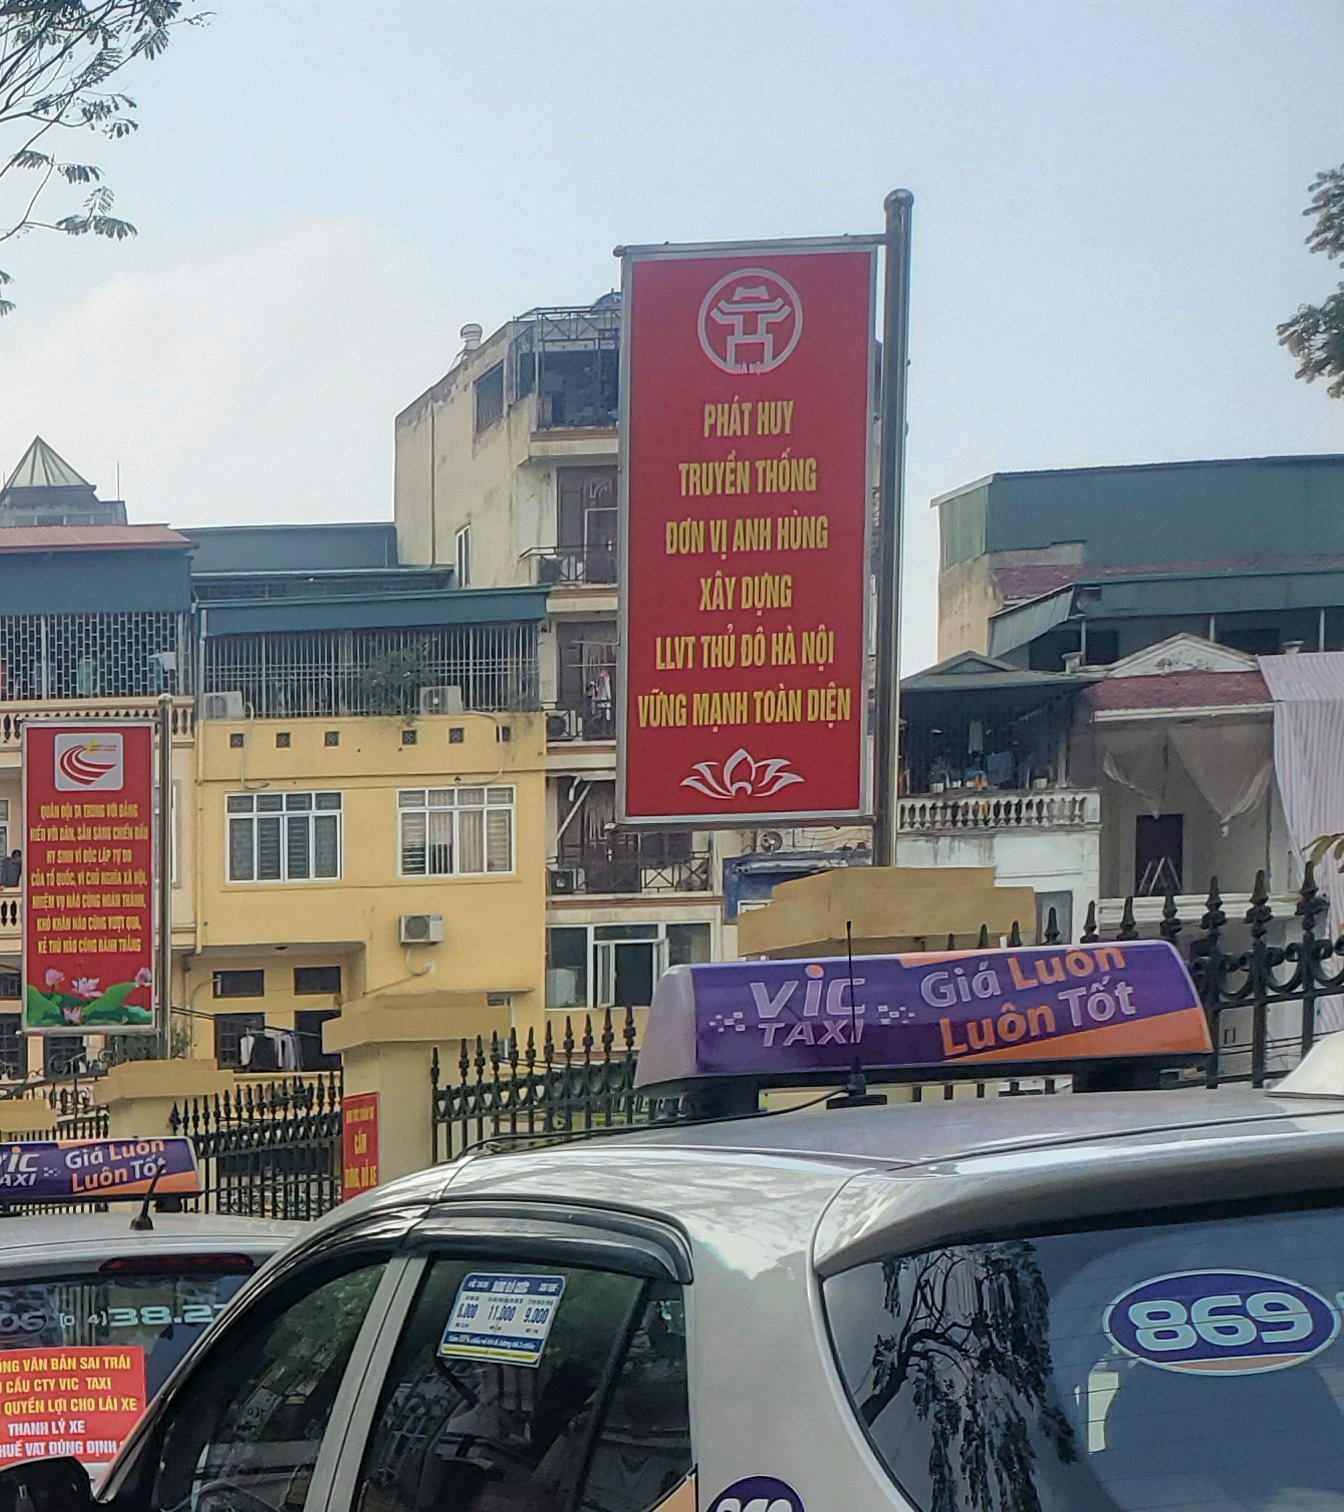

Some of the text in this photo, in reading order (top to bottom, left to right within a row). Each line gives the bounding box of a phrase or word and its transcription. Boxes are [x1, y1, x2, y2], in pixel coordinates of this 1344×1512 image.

[703, 395, 794, 437] PHÁT HUY
[678, 447, 816, 496] TRUYỀN THỐNG
[666, 509, 828, 560] ĐƠN VỊ ANH HÙNG
[699, 569, 792, 616] XÂY DỰNG
[656, 623, 834, 671] LLVT THỦ ĐÔ HÀ NỘI
[638, 681, 851, 732] VỮNG MẠNH TOÀN DIỆN
[920, 944, 1127, 1009] Giá Luôn
[761, 1020, 864, 1048] TAXI
[939, 974, 1138, 1057] Luôn Tốt
[65, 1140, 165, 1169] Giá Luôn
[71, 1154, 167, 1193] Luôn Tốt
[109, 1304, 226, 1328] 38.2
[1128, 1291, 1313, 1352] 869
[22, 1356, 48, 1372] VĂN
[51, 1354, 76, 1370] BẢN
[80, 1357, 100, 1369] SAI
[103, 1354, 131, 1369] TRÁI
[34, 1379, 56, 1392] CTY
[58, 1378, 79, 1391] VIC
[86, 1377, 112, 1390] TAXI
[48, 1398, 67, 1415] LỢI
[70, 1398, 95, 1412] CHO
[98, 1396, 118, 1411] LÁI
[121, 1398, 137, 1411] XE
[8, 1418, 85, 1437] THANH LÝ XE
[25, 1442, 46, 1456] VAT
[49, 1439, 83, 1455] ĐÚNG
[86, 1440, 116, 1458] ĐỊNH
